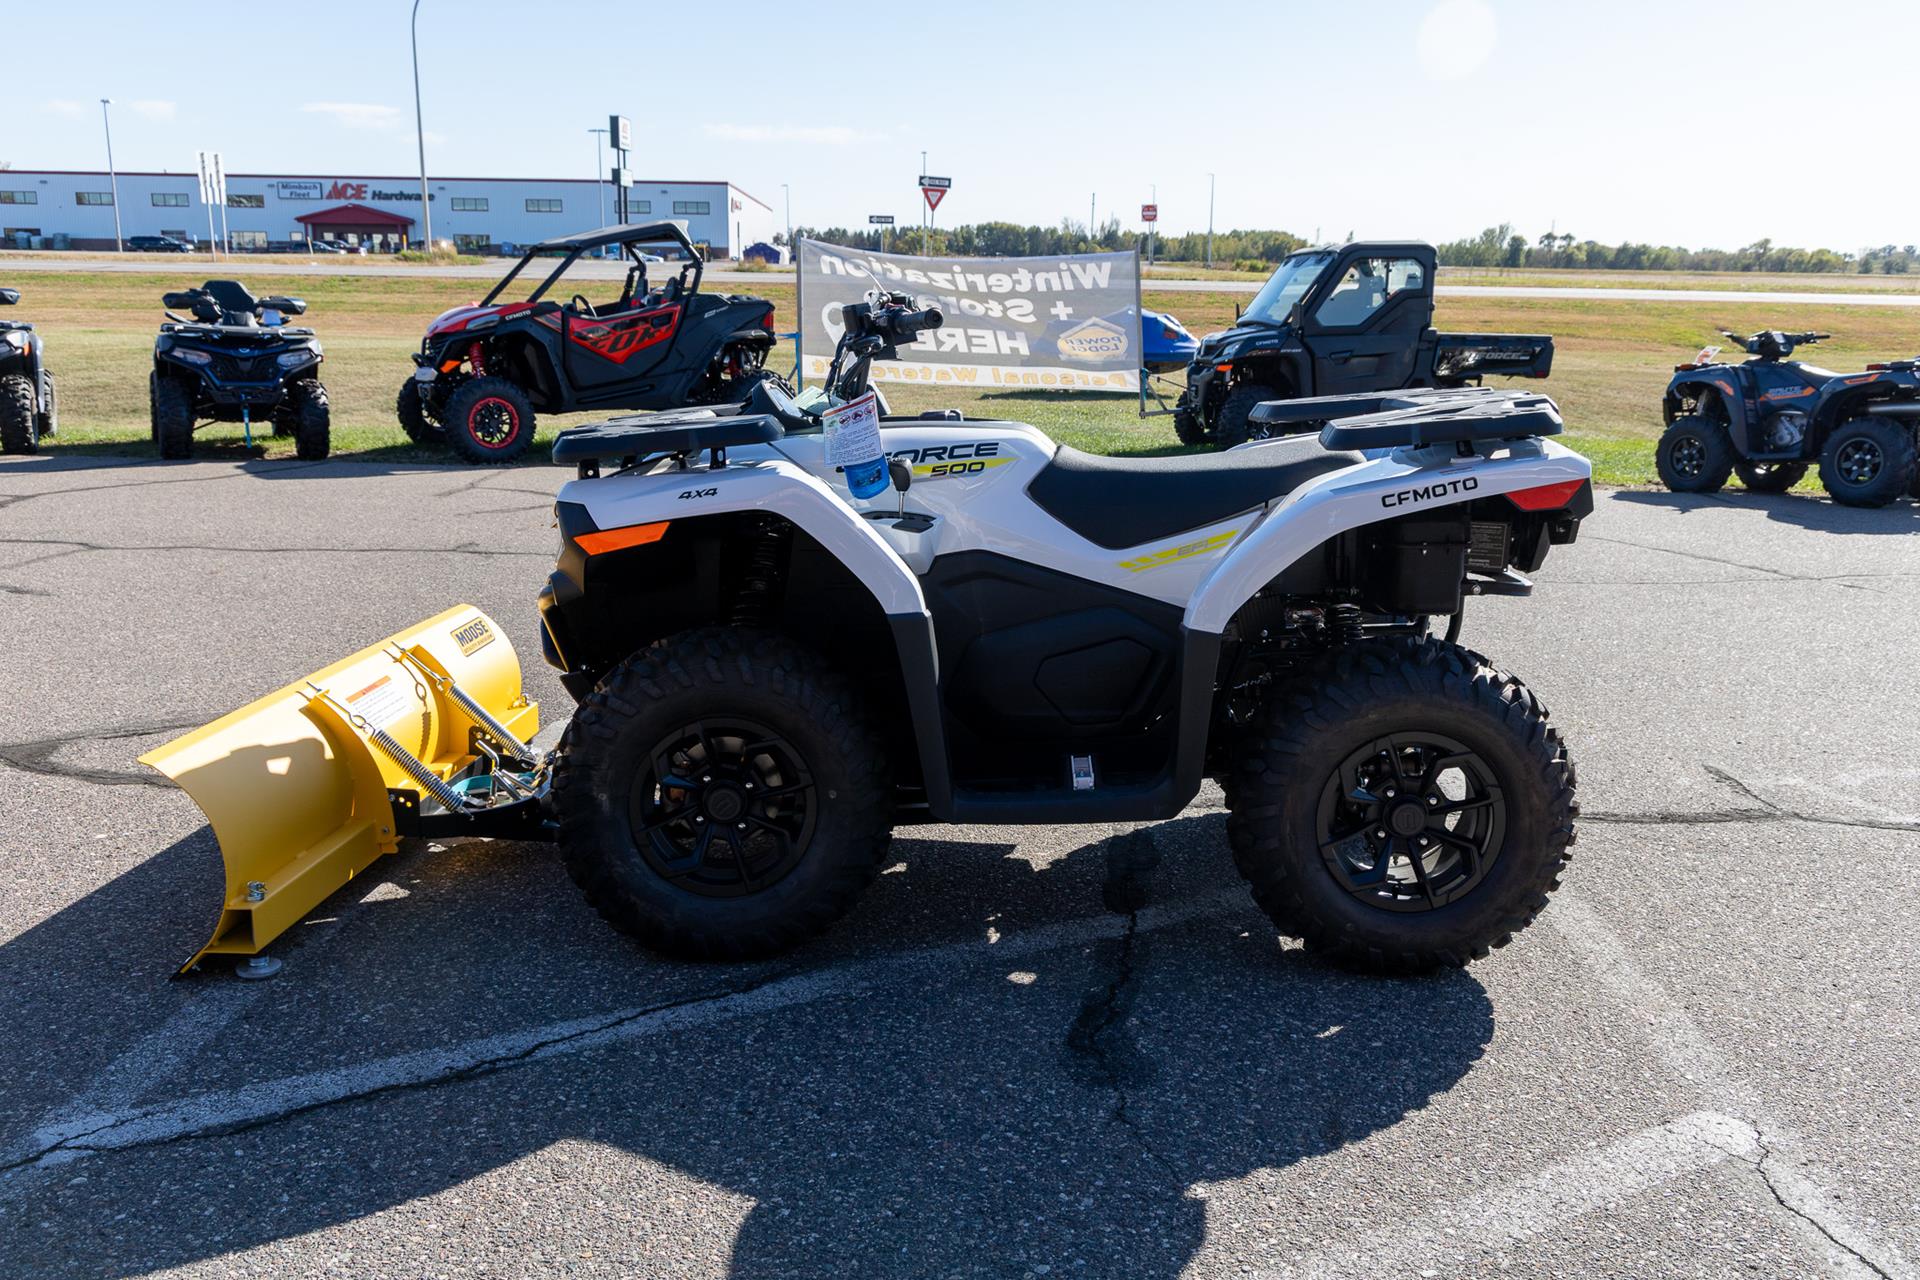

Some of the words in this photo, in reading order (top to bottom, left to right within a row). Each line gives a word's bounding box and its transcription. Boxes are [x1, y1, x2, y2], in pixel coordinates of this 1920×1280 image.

[326, 180, 368, 200] ACE
[371, 190, 435, 201] Hardwae
[930, 462, 985, 477] 500
[1381, 476, 1478, 508] CFMOTO
[455, 620, 489, 647] MOOSE
